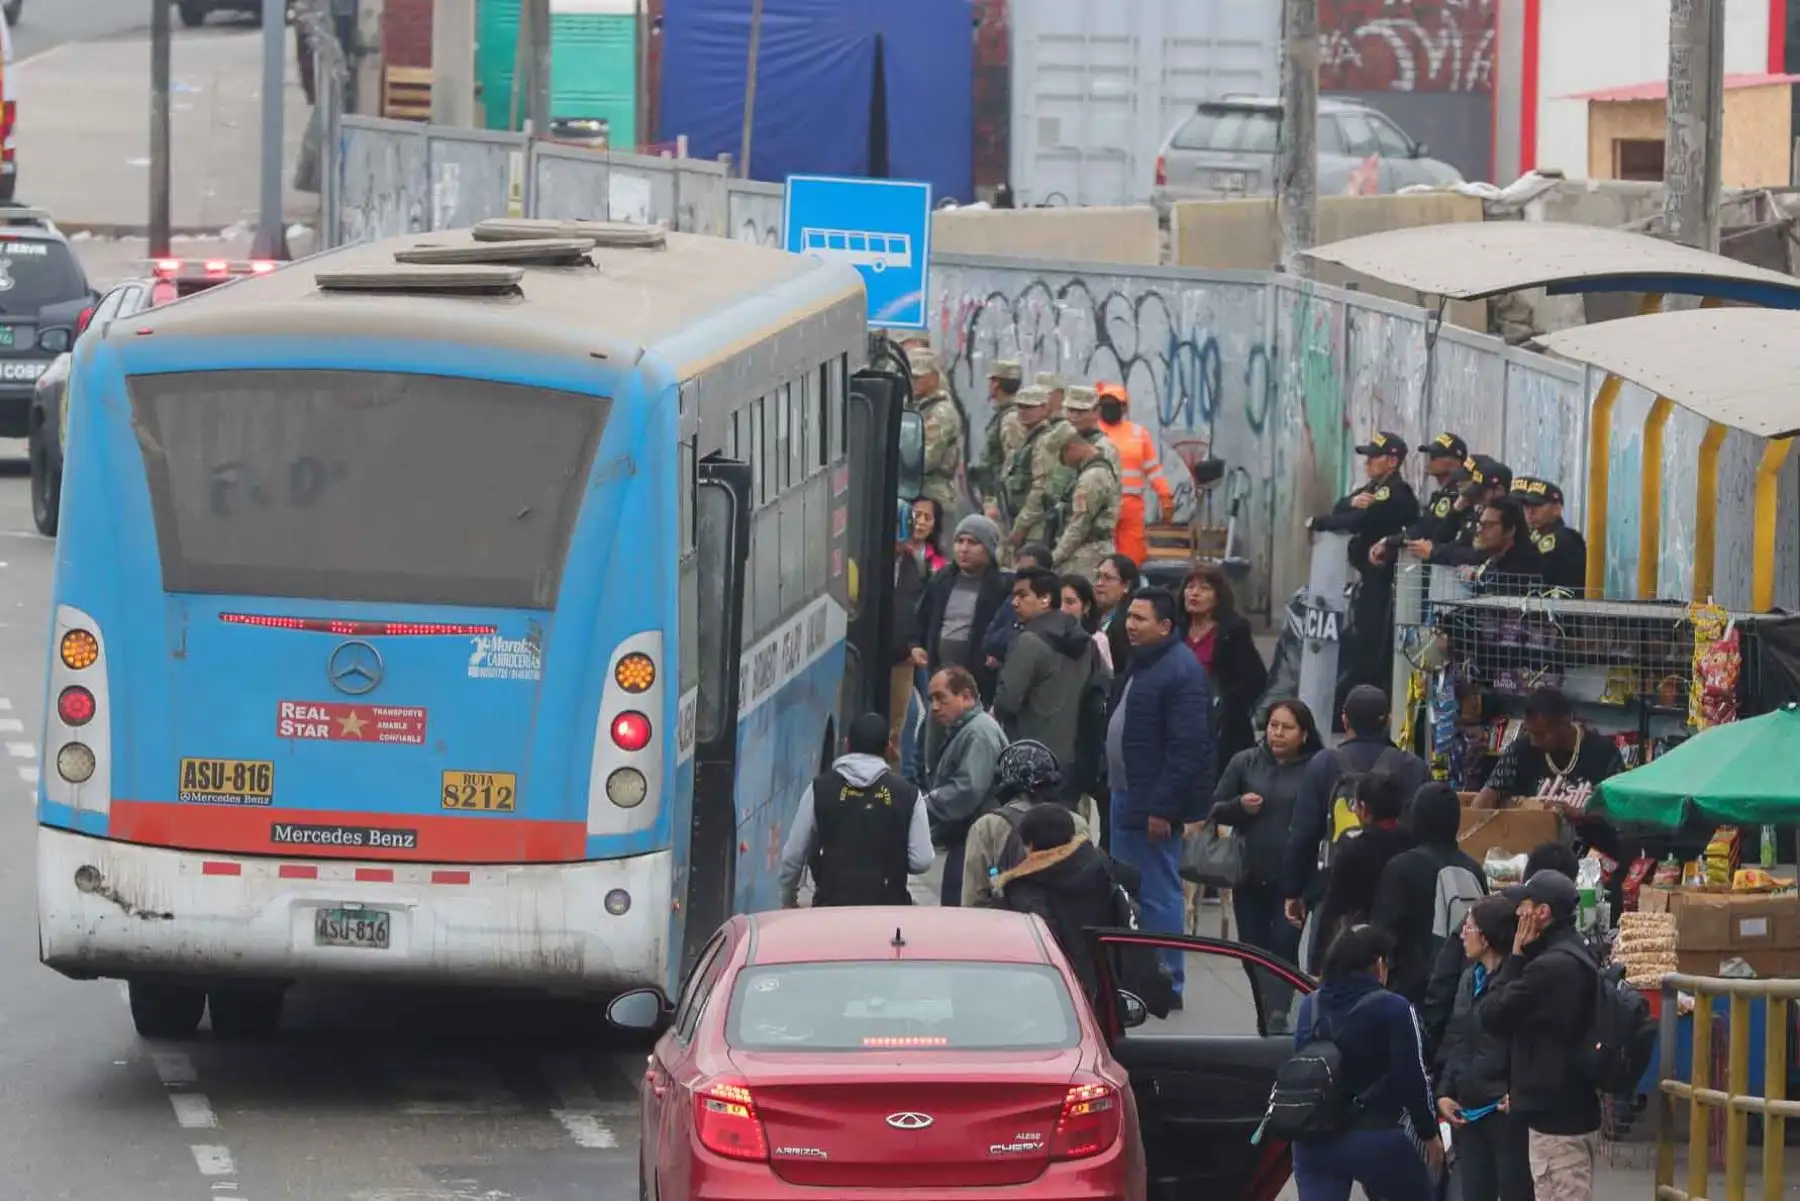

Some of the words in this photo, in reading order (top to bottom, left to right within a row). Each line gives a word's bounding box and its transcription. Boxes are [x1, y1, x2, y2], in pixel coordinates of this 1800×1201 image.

[281, 702, 331, 721] REAL
[279, 720, 330, 738] STAR
[183, 760, 271, 792] ASU-816
[462, 773, 495, 787] RUTA
[191, 792, 241, 804] Mercedes
[244, 794, 270, 805] Benz
[443, 784, 512, 809] 8212
[274, 825, 363, 846] Mercedes
[368, 829, 415, 848] Benz
[320, 918, 386, 941] ASU-816
